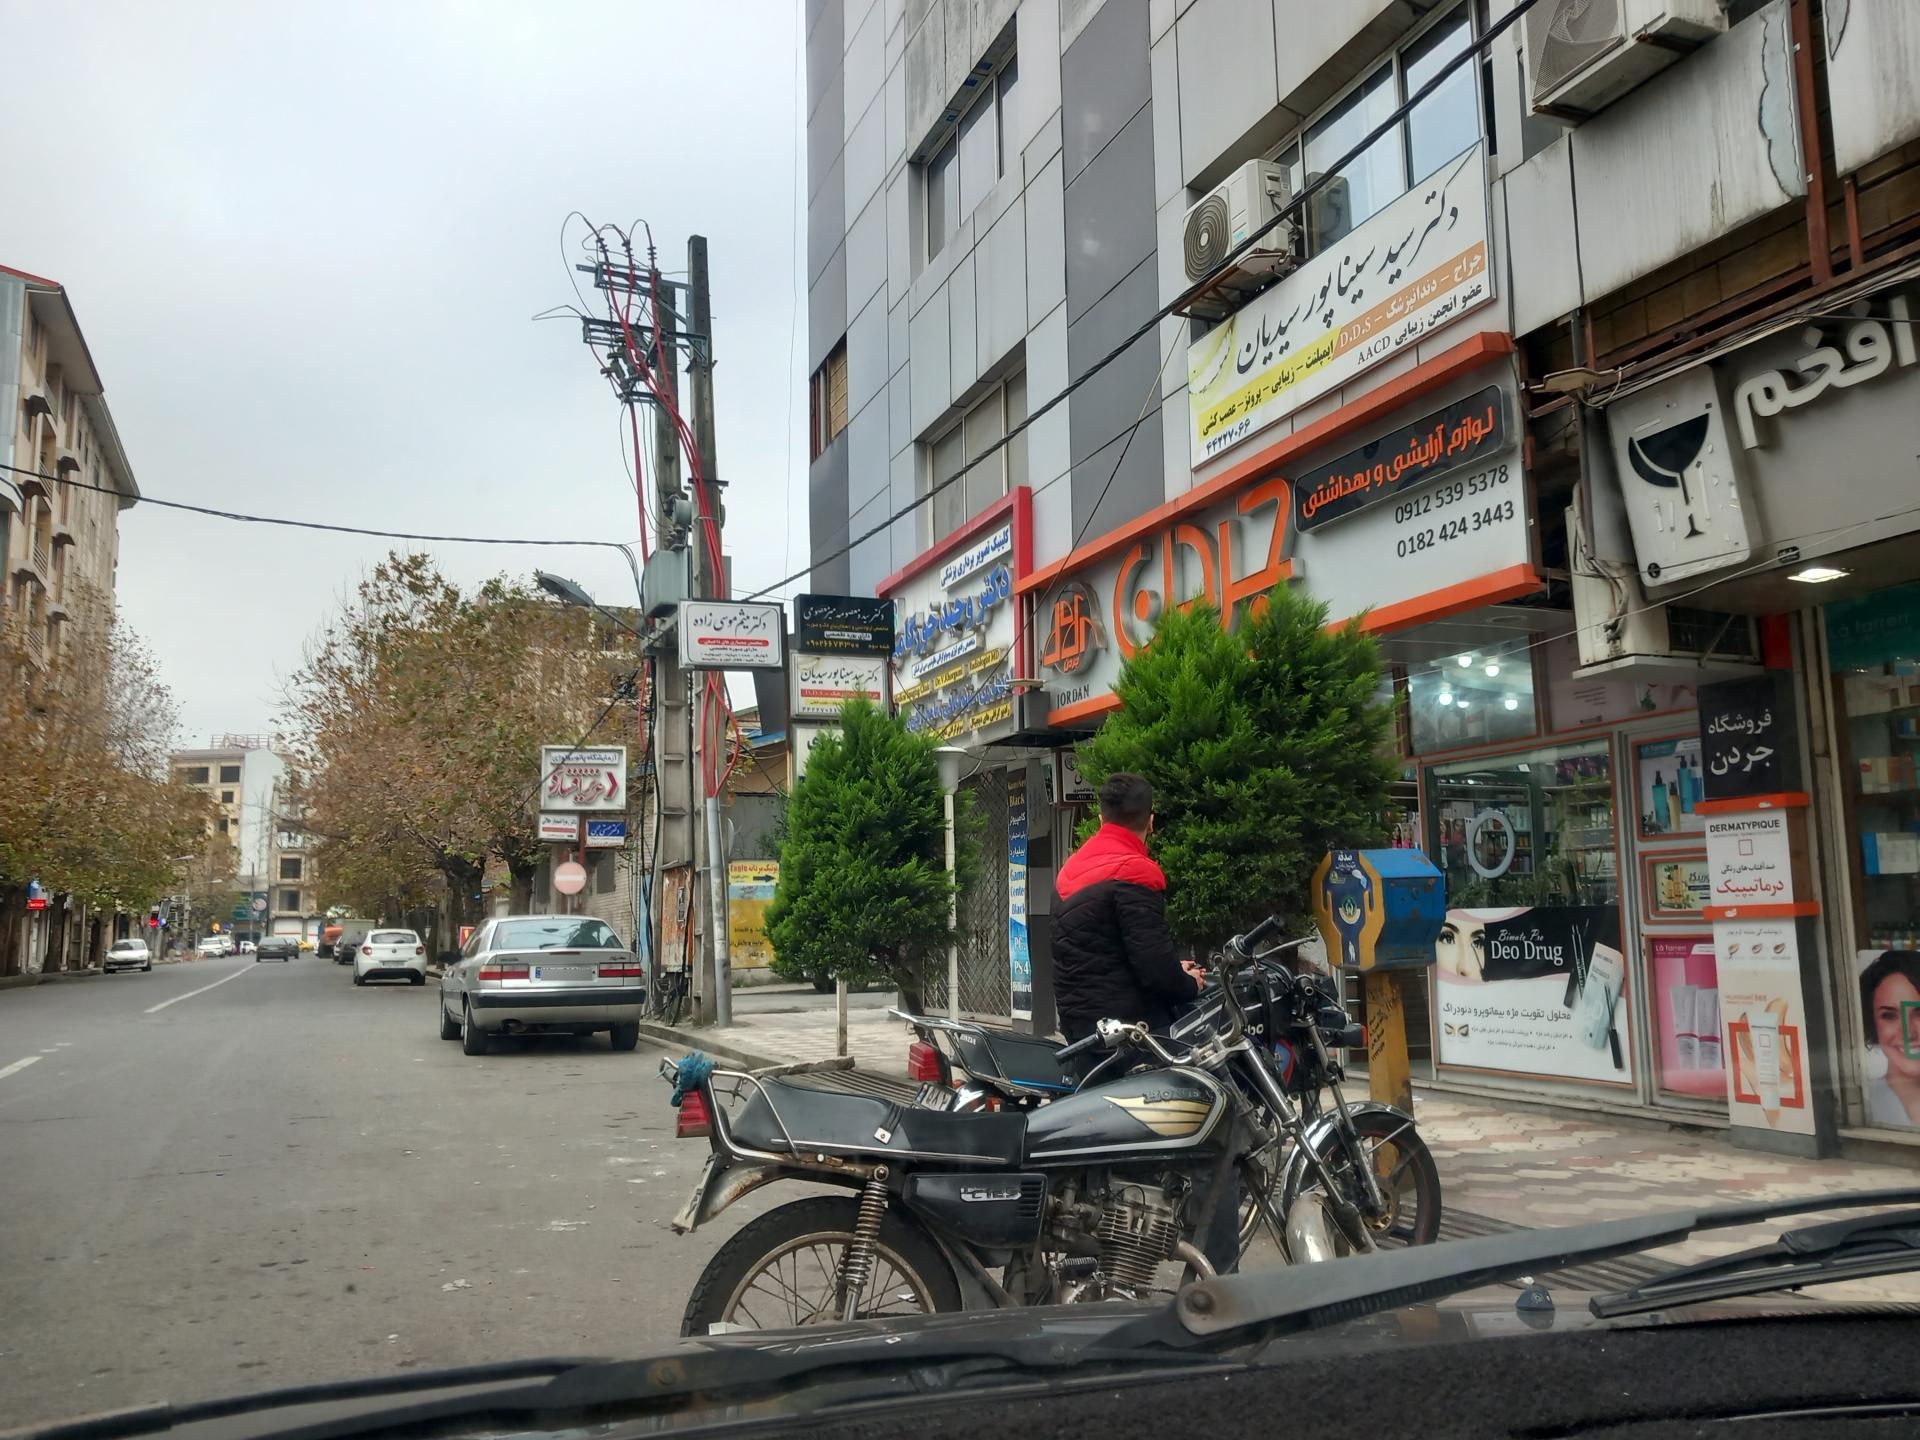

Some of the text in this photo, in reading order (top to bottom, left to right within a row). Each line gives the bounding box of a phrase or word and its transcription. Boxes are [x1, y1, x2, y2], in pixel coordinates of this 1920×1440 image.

[1408, 144, 1479, 267] دکتر
[1377, 226, 1415, 284] سید
[1339, 250, 1483, 349] جراح دندانپزشک D.D.S
[1357, 281, 1483, 366] عضو انجمن زیبایی AACD
[1305, 337, 1335, 370] ایمپلنت
[1270, 364, 1295, 395] زیبایی
[1202, 411, 1219, 437] کشی
[1218, 401, 1237, 424] عصب
[1302, 405, 1495, 519] لوازم آرایشی و بهداشتی
[1395, 463, 1510, 525] 0912 539 5378
[991, 527, 1009, 553] کلینیک
[1397, 499, 1515, 559] 0182 424 3443
[957, 554, 975, 577] برداری
[976, 541, 990, 566] تصویر
[975, 562, 1010, 625] دکتر
[692, 608, 772, 637] دکتر میثم موسی زاده
[869, 601, 889, 624] دکتر
[864, 664, 881, 684] دکتر
[1055, 684, 1090, 709] JORDAN
[1707, 708, 1773, 735] فروشگاه
[1710, 743, 1775, 776] جردن
[1709, 819, 1781, 834] DERMATYPIQUE
[1716, 877, 1785, 898] درماتیپیک
[1491, 940, 1564, 967] Deo Drug
[1012, 980, 1032, 993] Billiard
[1473, 1006, 1505, 1019] بیماتوپرو
[1506, 1008, 1519, 1022] مژه
[1520, 1008, 1545, 1020] تقویت
[1546, 1009, 1572, 1022] محلول
